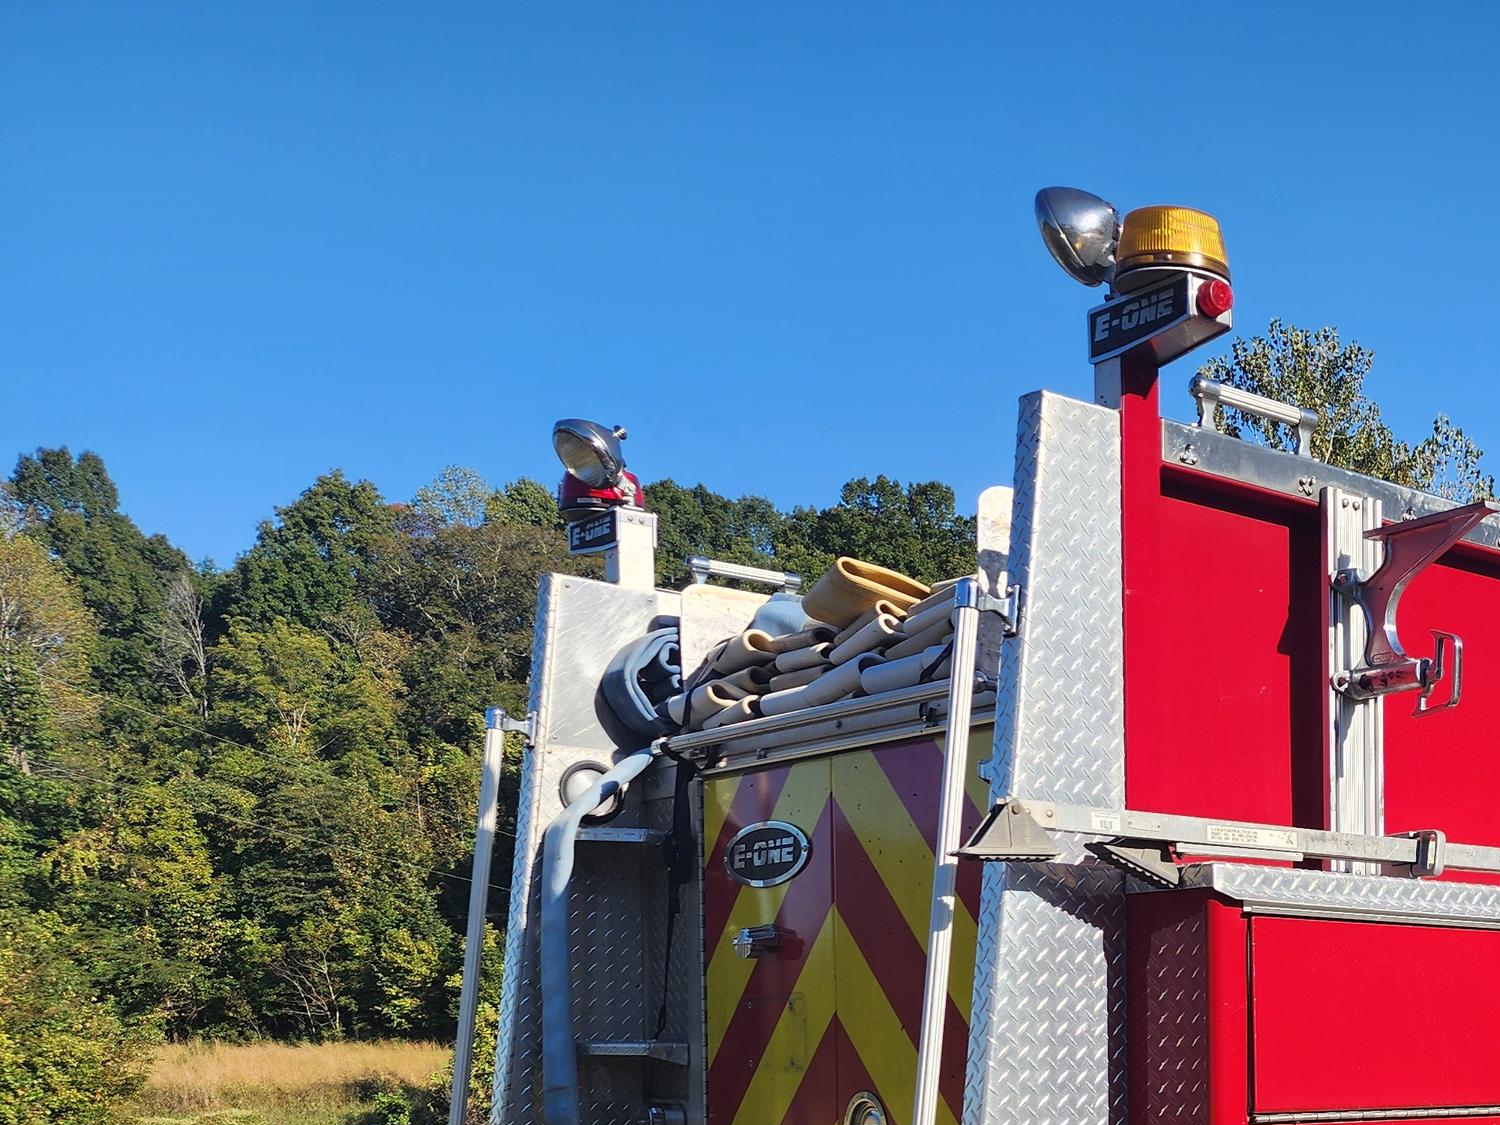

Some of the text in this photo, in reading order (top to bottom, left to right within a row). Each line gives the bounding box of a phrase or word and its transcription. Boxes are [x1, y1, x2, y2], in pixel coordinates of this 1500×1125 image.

[1095, 288, 1175, 342] E-ONE
[572, 516, 611, 546] E-ONE
[733, 837, 794, 869] E-ONE
